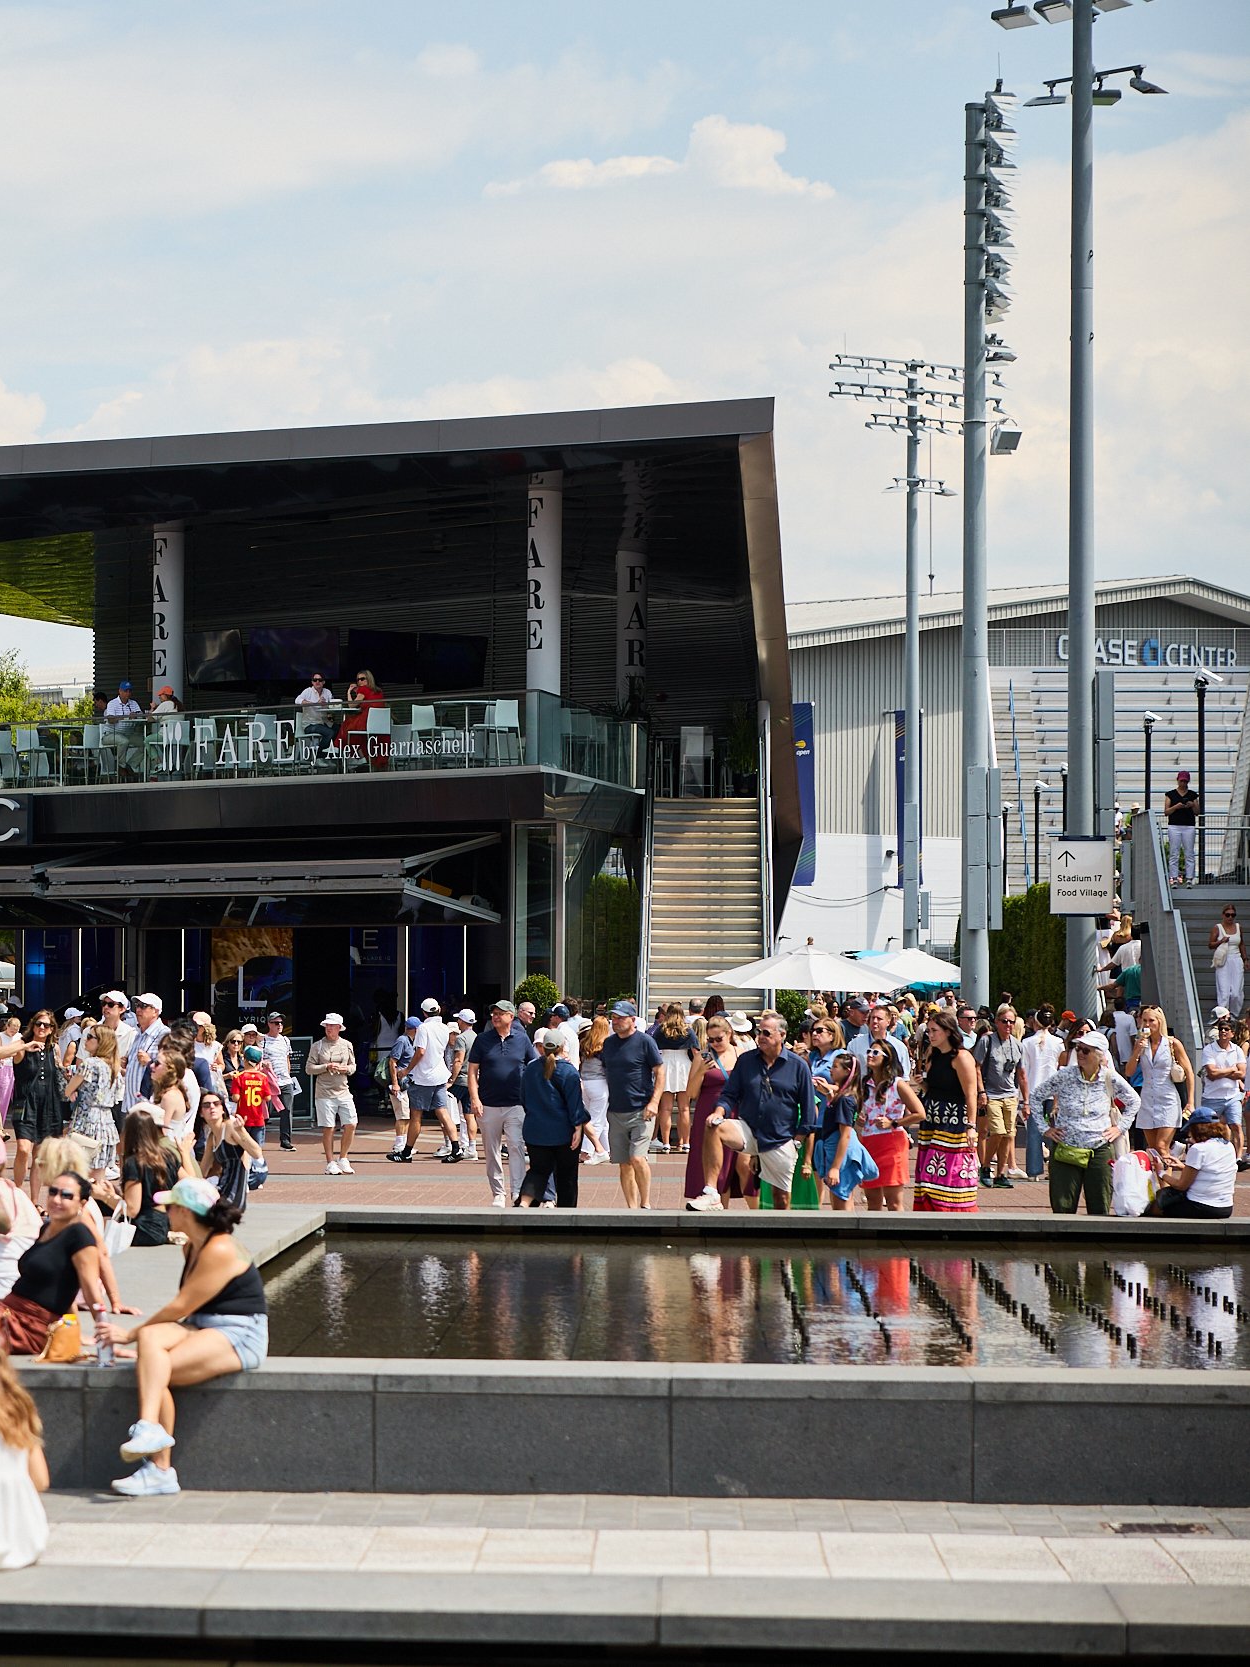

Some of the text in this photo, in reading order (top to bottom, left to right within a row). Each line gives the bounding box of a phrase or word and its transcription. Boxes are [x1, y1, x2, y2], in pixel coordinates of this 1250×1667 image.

[527, 497, 546, 651] FARE
[152, 537, 169, 677] FARE
[1058, 634, 1237, 667] CASE CENTER
[193, 719, 476, 766] FARE by Alex Guarnaschelli
[1057, 874, 1103, 882] Stadium 17
[1057, 889, 1108, 898] Food Village
[238, 1016, 267, 1024] LYRIQ
[244, 1086, 262, 1107] 16
